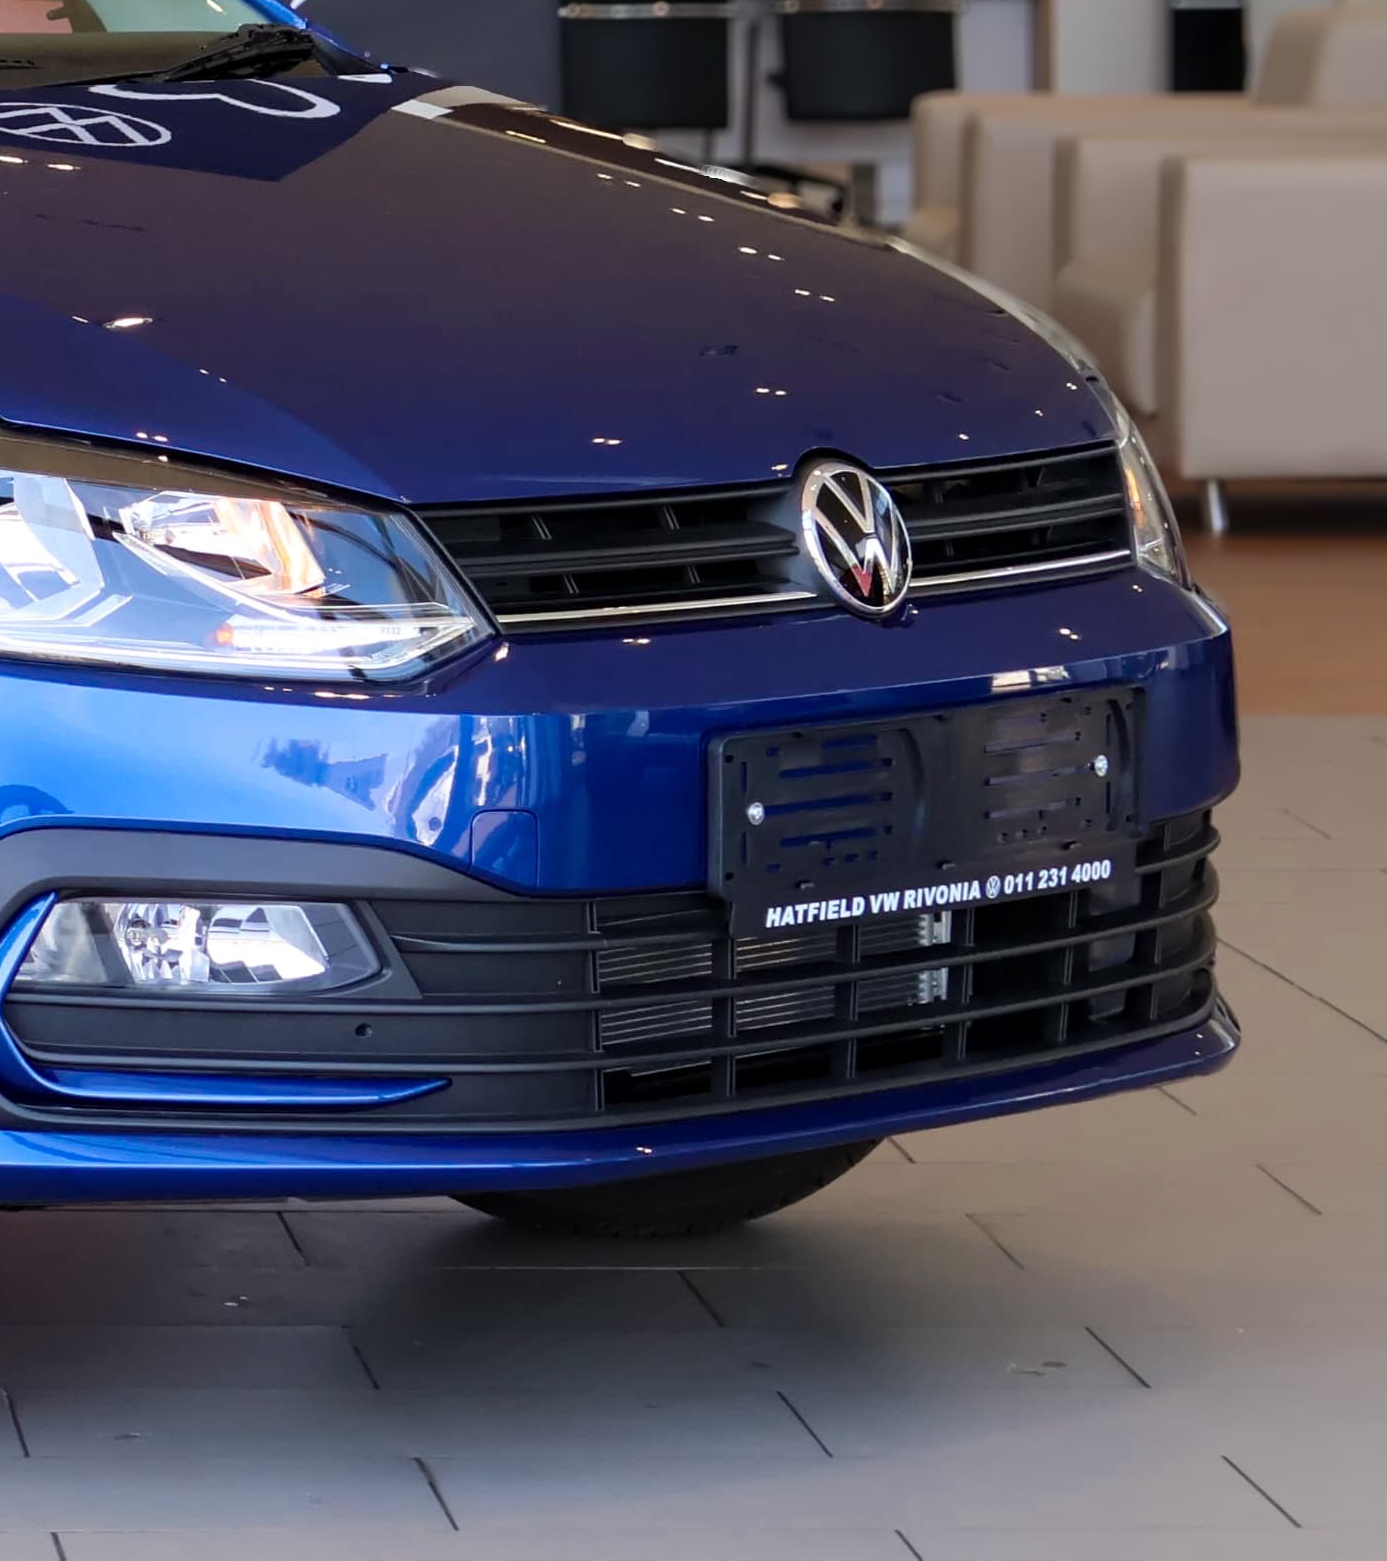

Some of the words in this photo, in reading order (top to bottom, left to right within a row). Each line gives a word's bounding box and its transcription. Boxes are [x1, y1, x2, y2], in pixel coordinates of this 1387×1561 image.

[802, 462, 913, 614] VW
[765, 896, 866, 928] HATFIELD
[869, 890, 901, 915] VW
[903, 879, 982, 910] RIVONIA
[1004, 871, 1034, 895] 011
[1037, 866, 1068, 890] 231
[1071, 859, 1112, 883] 4000
